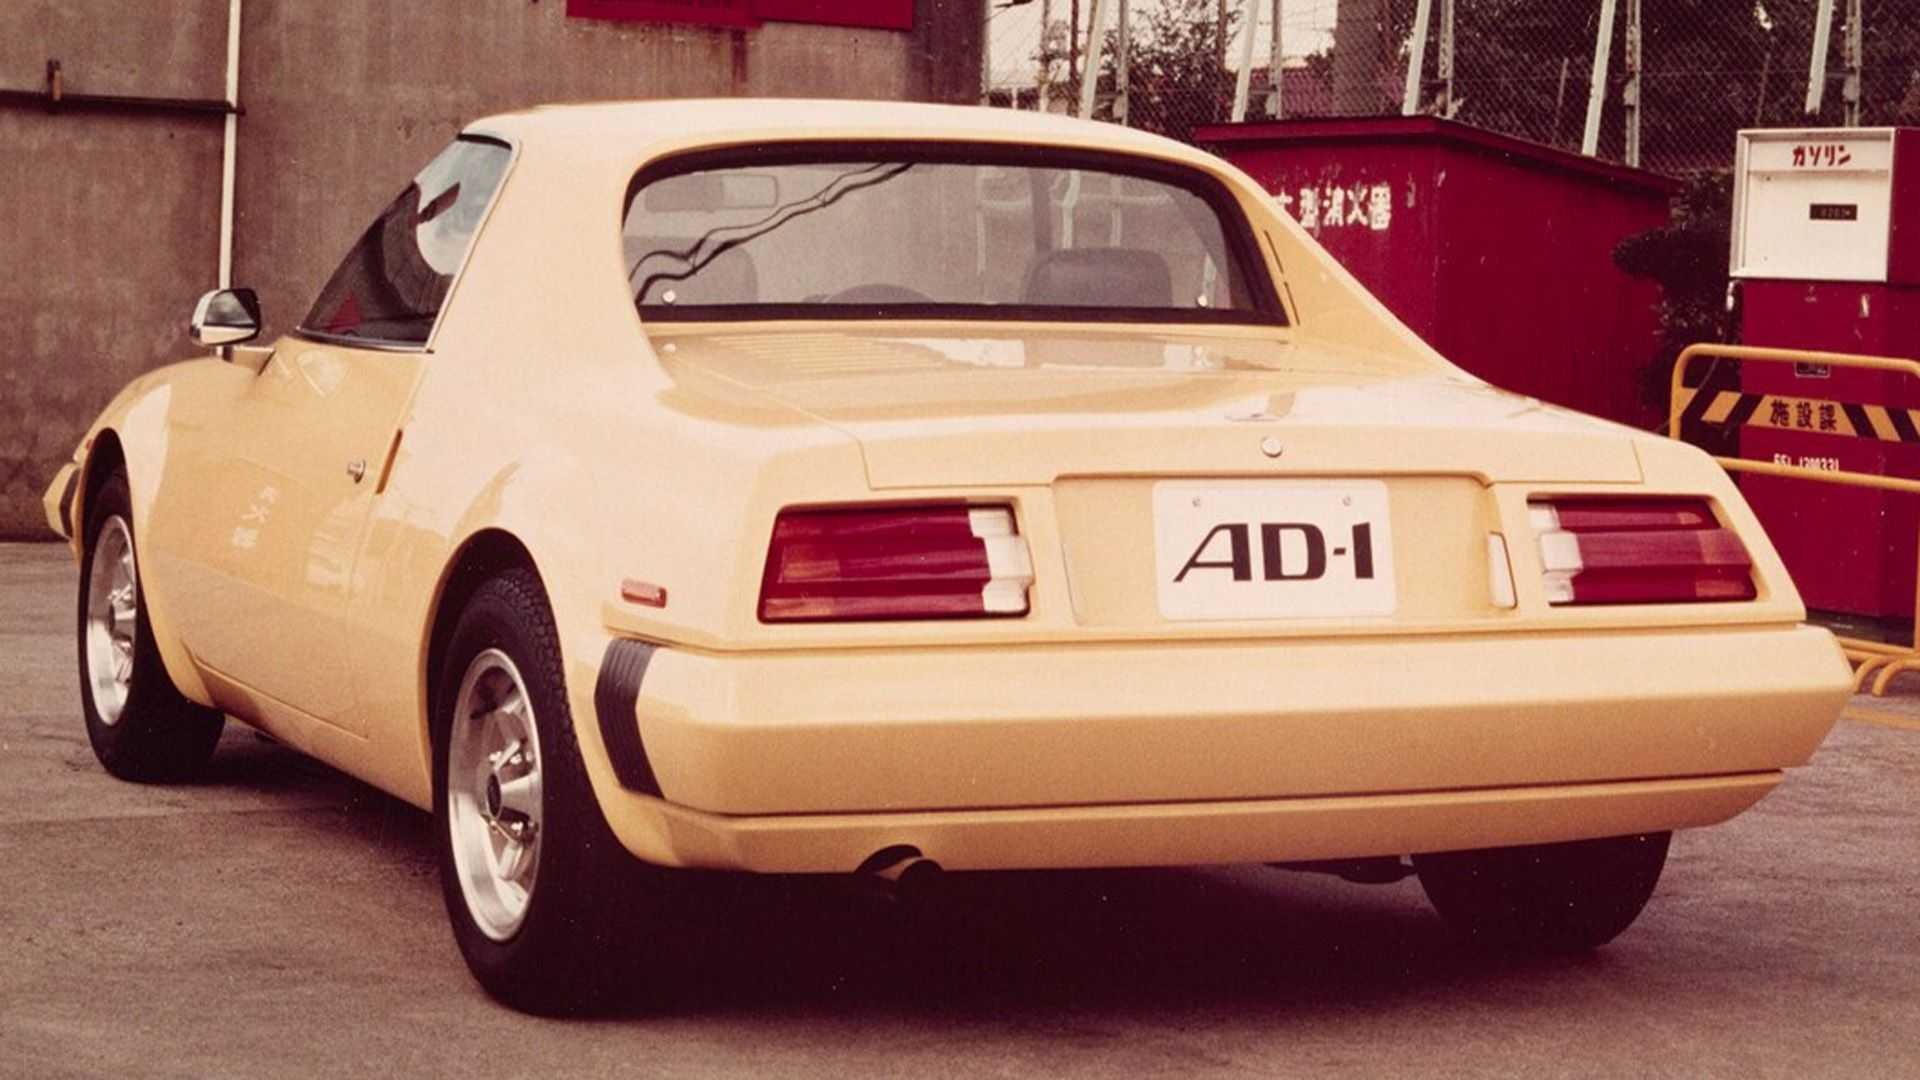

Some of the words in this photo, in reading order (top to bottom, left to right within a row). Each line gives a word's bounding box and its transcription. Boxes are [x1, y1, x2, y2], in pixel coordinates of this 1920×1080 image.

[1793, 144, 1851, 167] ガソリン
[1173, 521, 1375, 583] AD-1
